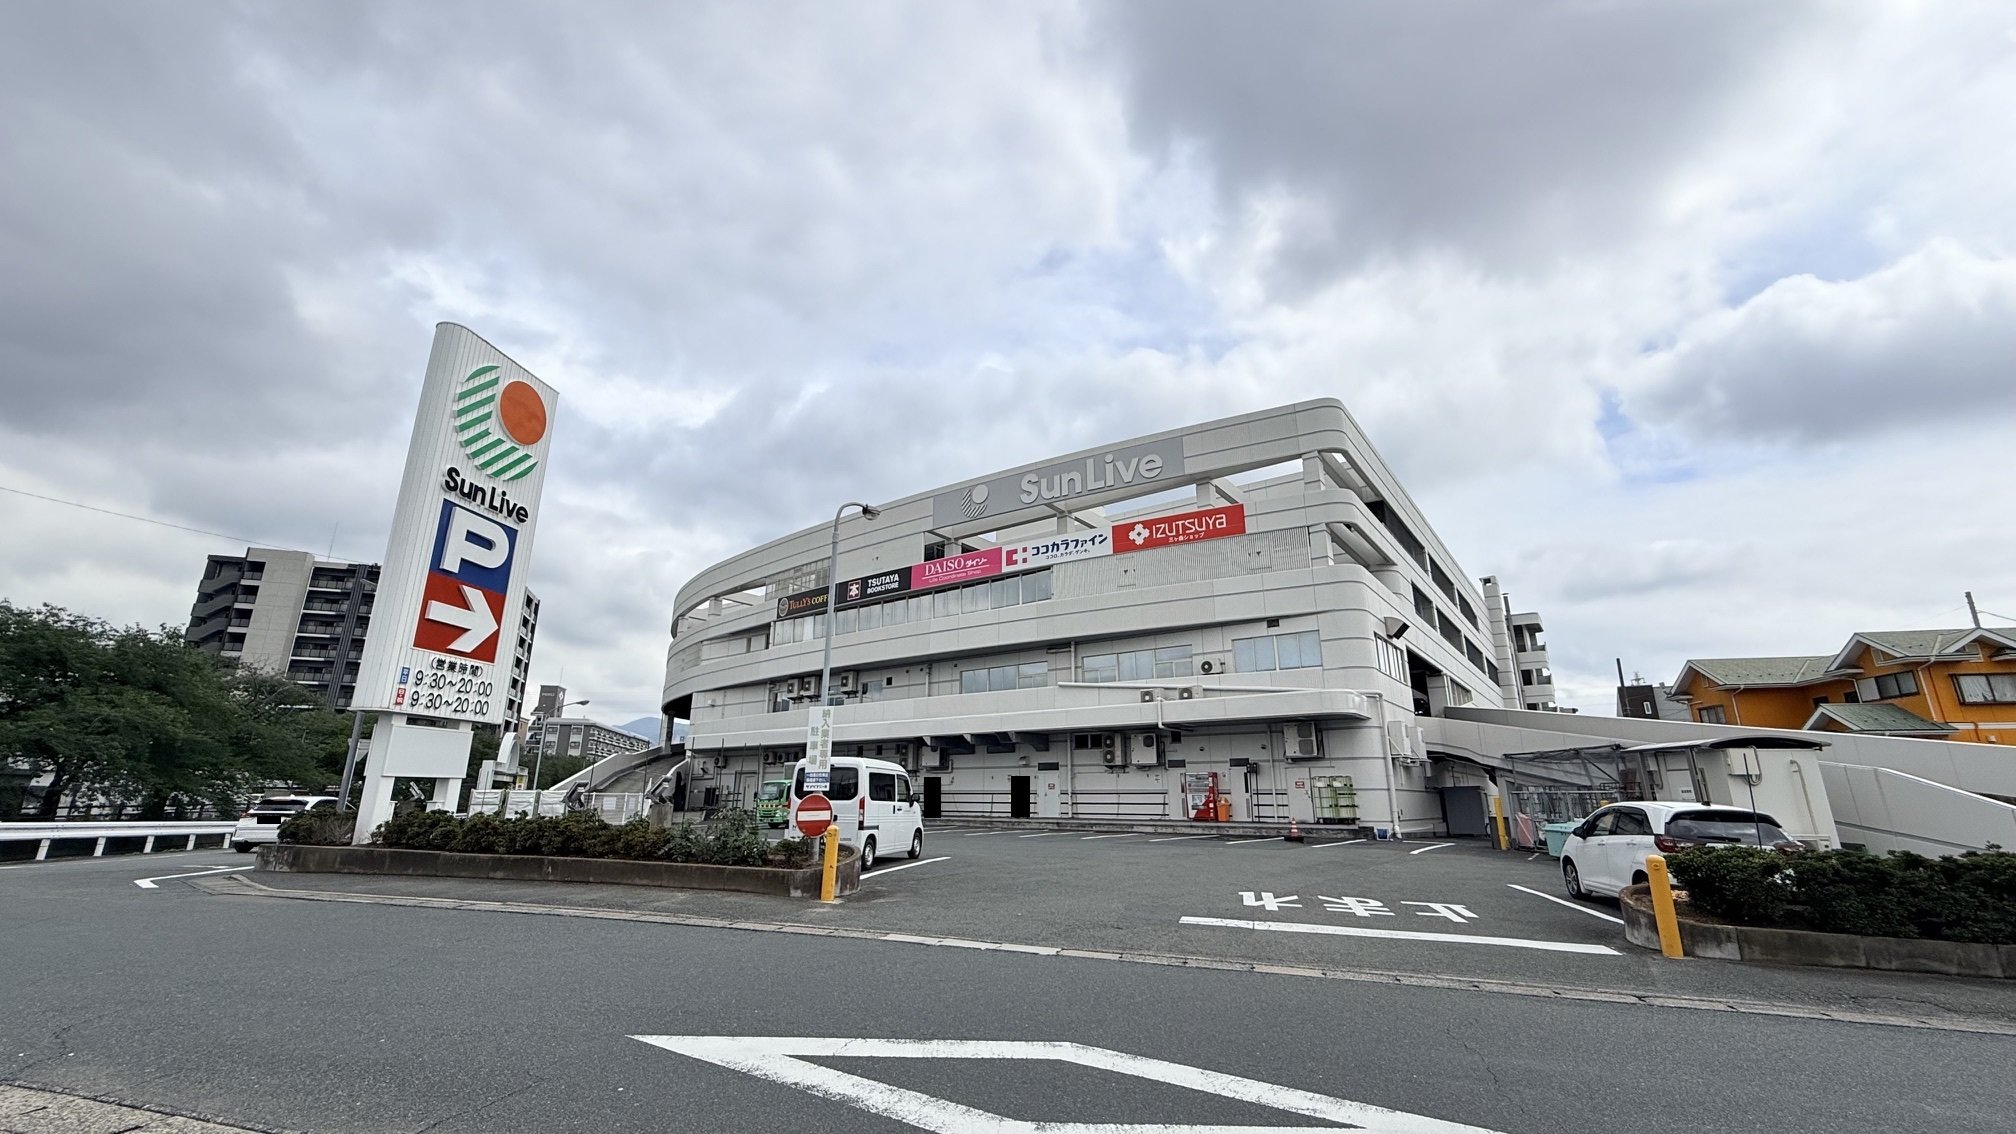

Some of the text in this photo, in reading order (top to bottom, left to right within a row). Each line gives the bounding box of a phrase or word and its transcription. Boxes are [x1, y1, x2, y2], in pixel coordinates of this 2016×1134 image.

[439, 507, 510, 574] P
[1031, 534, 1107, 556] ココカラファイン
[925, 557, 964, 576] DAISO
[965, 557, 988, 567] ダイソー
[866, 582, 899, 594] BOOKSTORE
[867, 573, 899, 587] TSUTAYA
[1238, 891, 1480, 923] 止まれ
